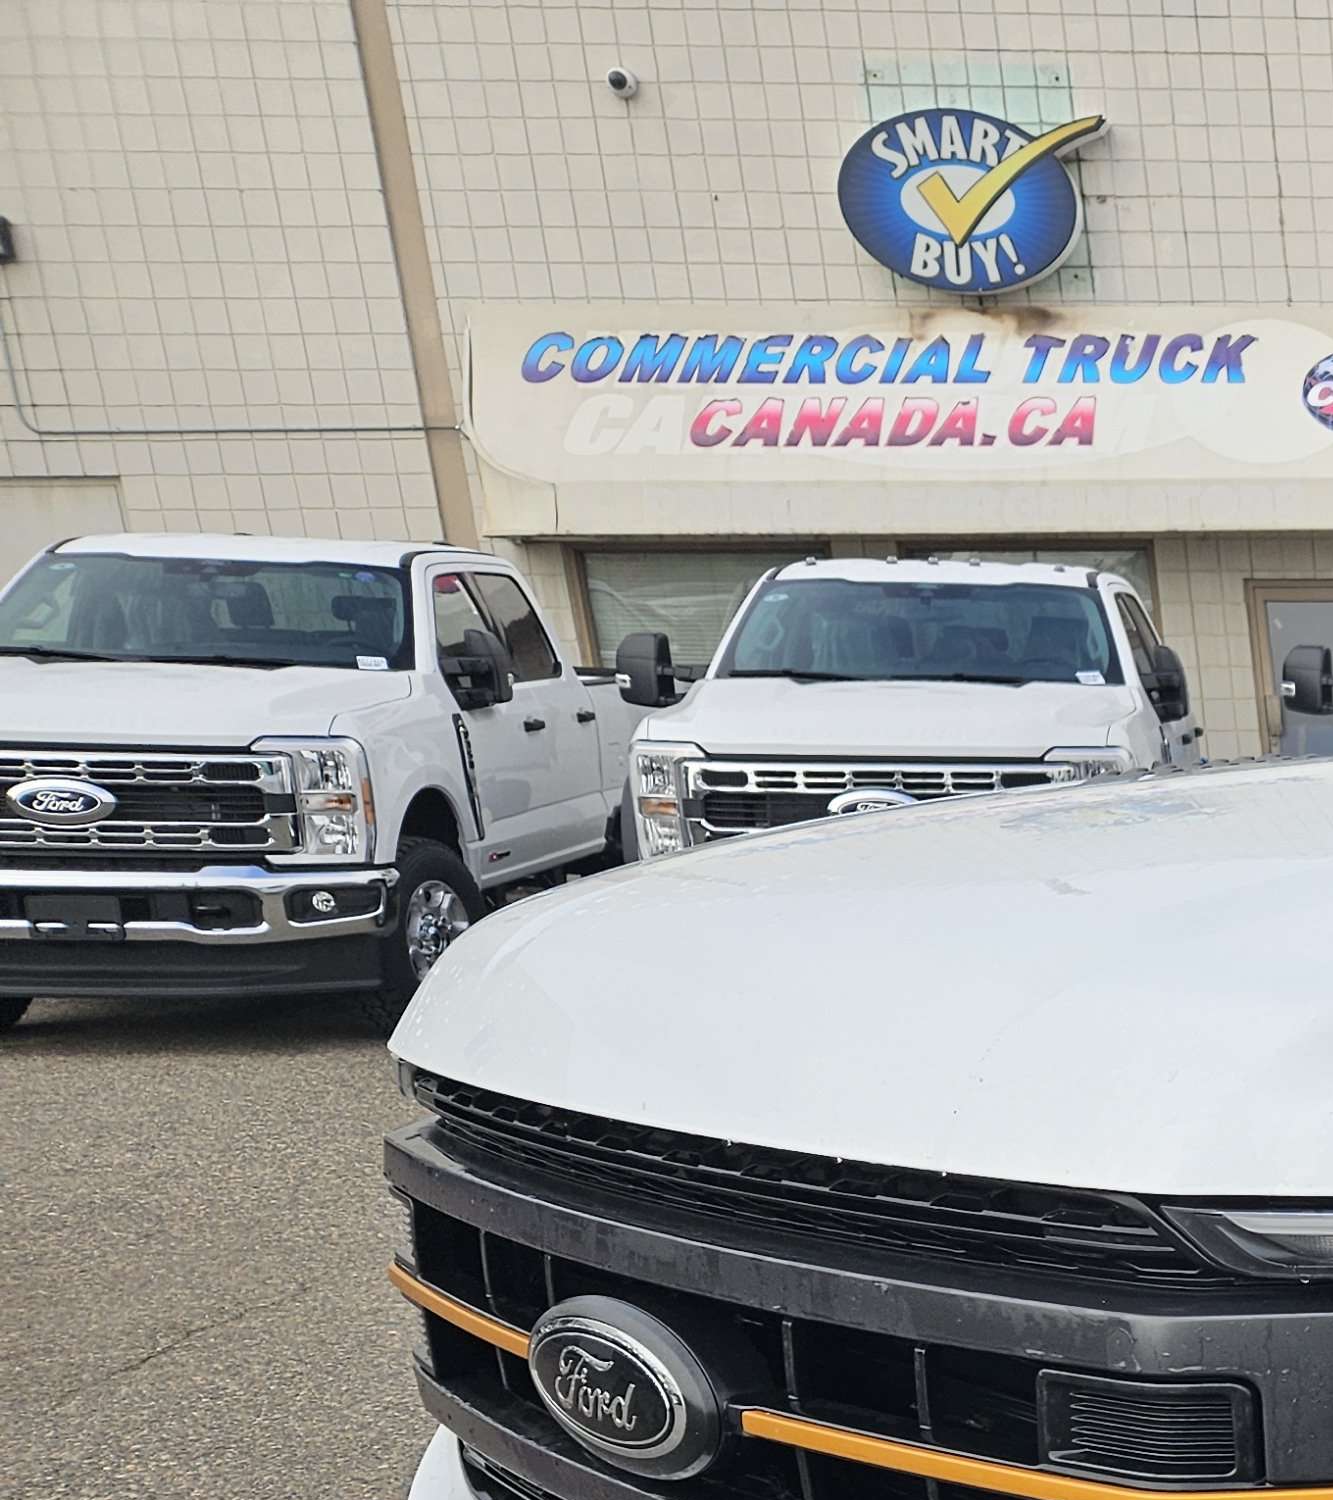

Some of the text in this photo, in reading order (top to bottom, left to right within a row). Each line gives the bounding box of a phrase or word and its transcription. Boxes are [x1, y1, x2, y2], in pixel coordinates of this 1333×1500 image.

[871, 115, 1030, 179] SMART
[910, 232, 1026, 285] BUY!
[520, 331, 1258, 385] COMMERCIAL TRUCK
[689, 395, 1097, 448] CANADA.CA
[32, 790, 84, 812] Ford
[555, 1345, 638, 1431] Ford
